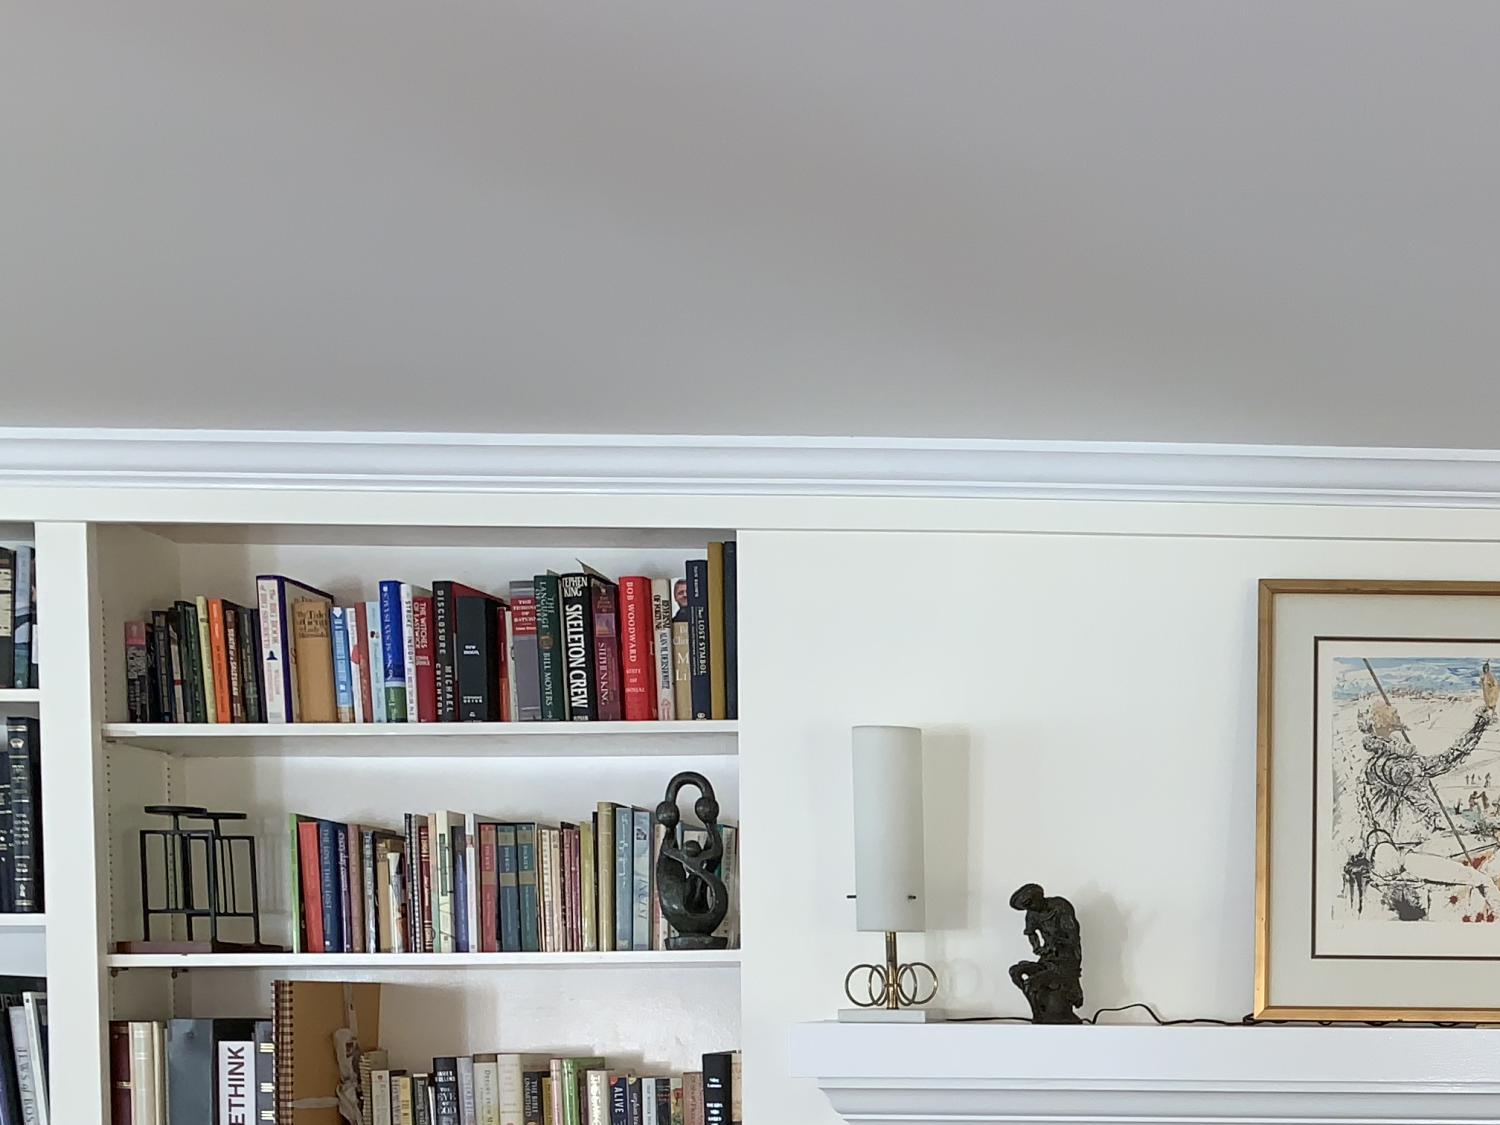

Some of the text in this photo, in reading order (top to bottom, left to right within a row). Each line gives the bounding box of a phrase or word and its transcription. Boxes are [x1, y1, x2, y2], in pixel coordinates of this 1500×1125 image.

[561, 576, 588, 587] TEPHEN
[437, 590, 446, 655] DISCLOSURE
[626, 581, 637, 662] BOB WOODWARD
[543, 652, 553, 706] BILL MOYERS
[565, 604, 588, 708] SKELETON CREW
[435, 663, 443, 715] CRICHTON
[445, 665, 454, 713] MICHAEL
[614, 1087, 624, 1113] ALIVE
